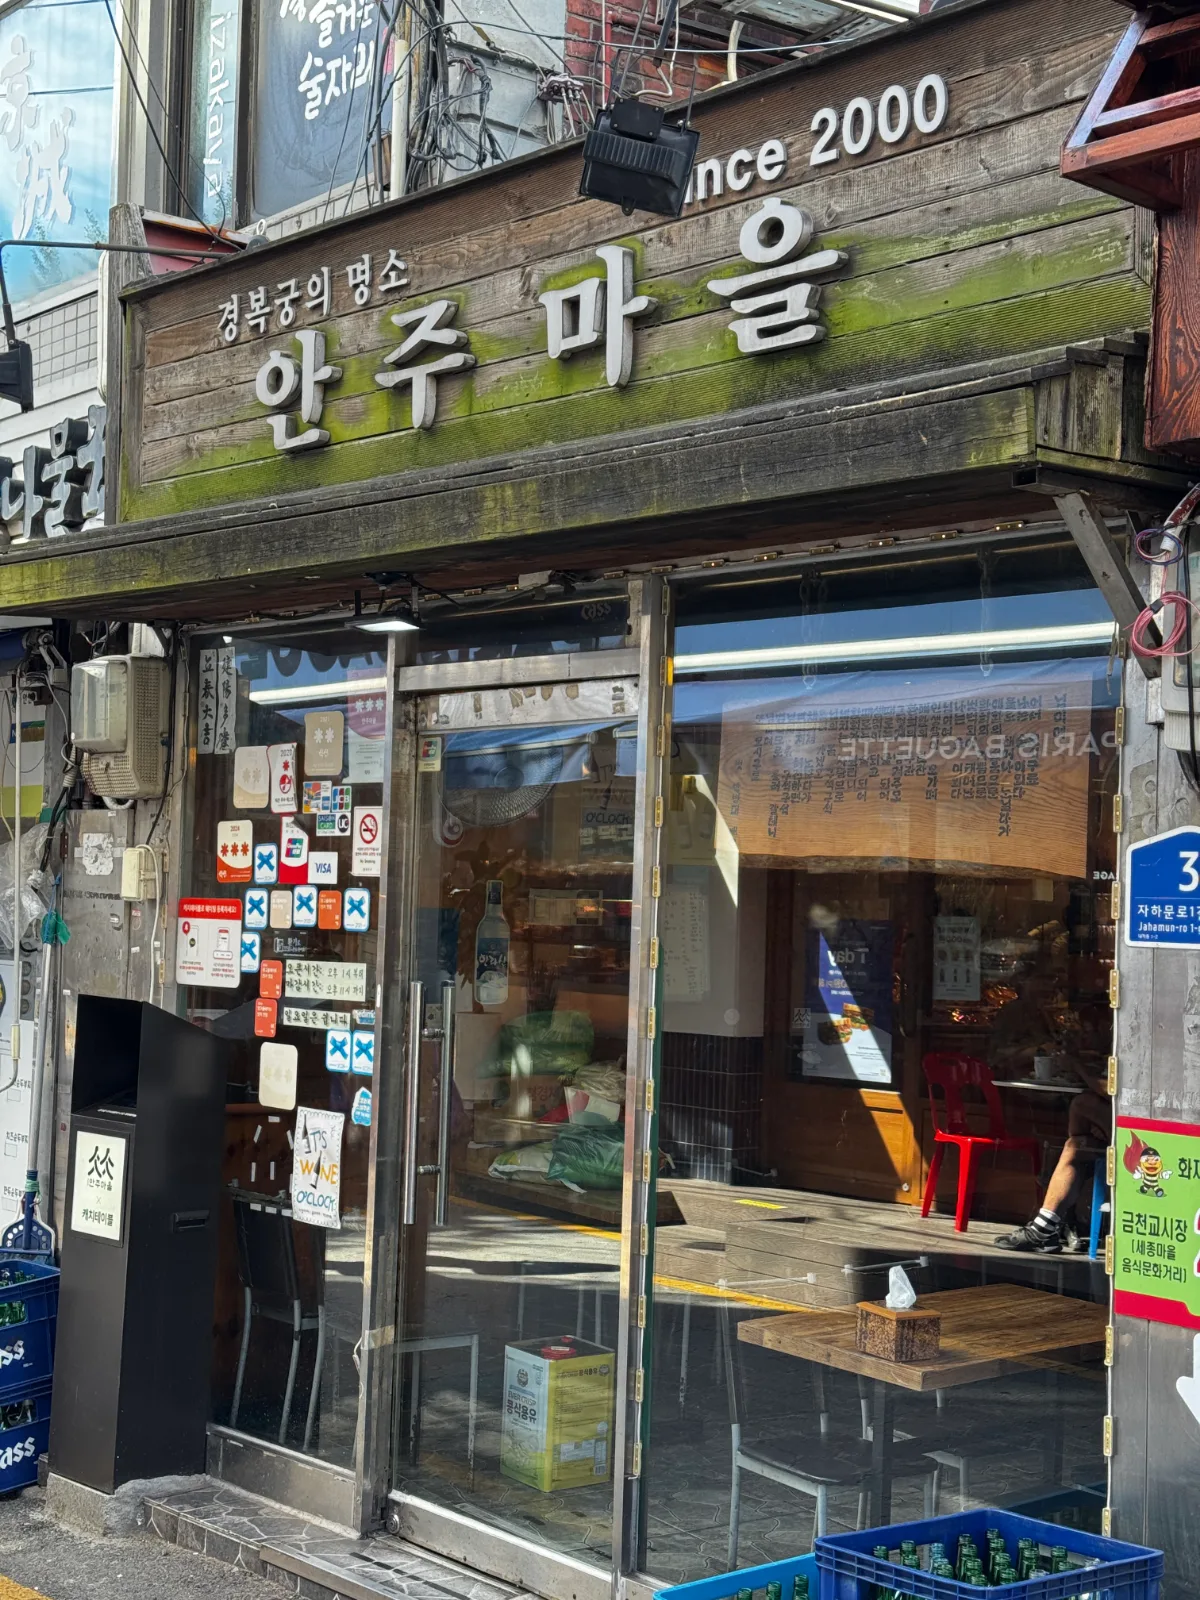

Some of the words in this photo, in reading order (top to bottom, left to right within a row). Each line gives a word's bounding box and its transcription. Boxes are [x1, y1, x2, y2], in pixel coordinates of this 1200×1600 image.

[298, 40, 375, 121] 술자리
[202, 11, 232, 198] izakaya
[683, 139, 787, 204] nce
[809, 74, 950, 167] 2000
[218, 266, 332, 343] 경복궁의
[346, 249, 410, 307] 명소
[256, 197, 850, 451] 안주마을
[202, 654, 214, 746] 立春大吉
[315, 863, 332, 874] VISA
[1137, 921, 1188, 933] Jahamun-ro
[327, 968, 338, 979] 오후
[326, 984, 338, 996] 오후
[297, 1190, 335, 1212] O'CLOCK
[81, 1208, 114, 1227] 캐치테이블
[1122, 1210, 1188, 1243] 금천교시장
[1131, 1238, 1176, 1261] (세종마을
[1121, 1257, 1187, 1284] 음식문화거리)
[506, 1398, 537, 1425] 콩식용유
[0, 1436, 36, 1470] ass
